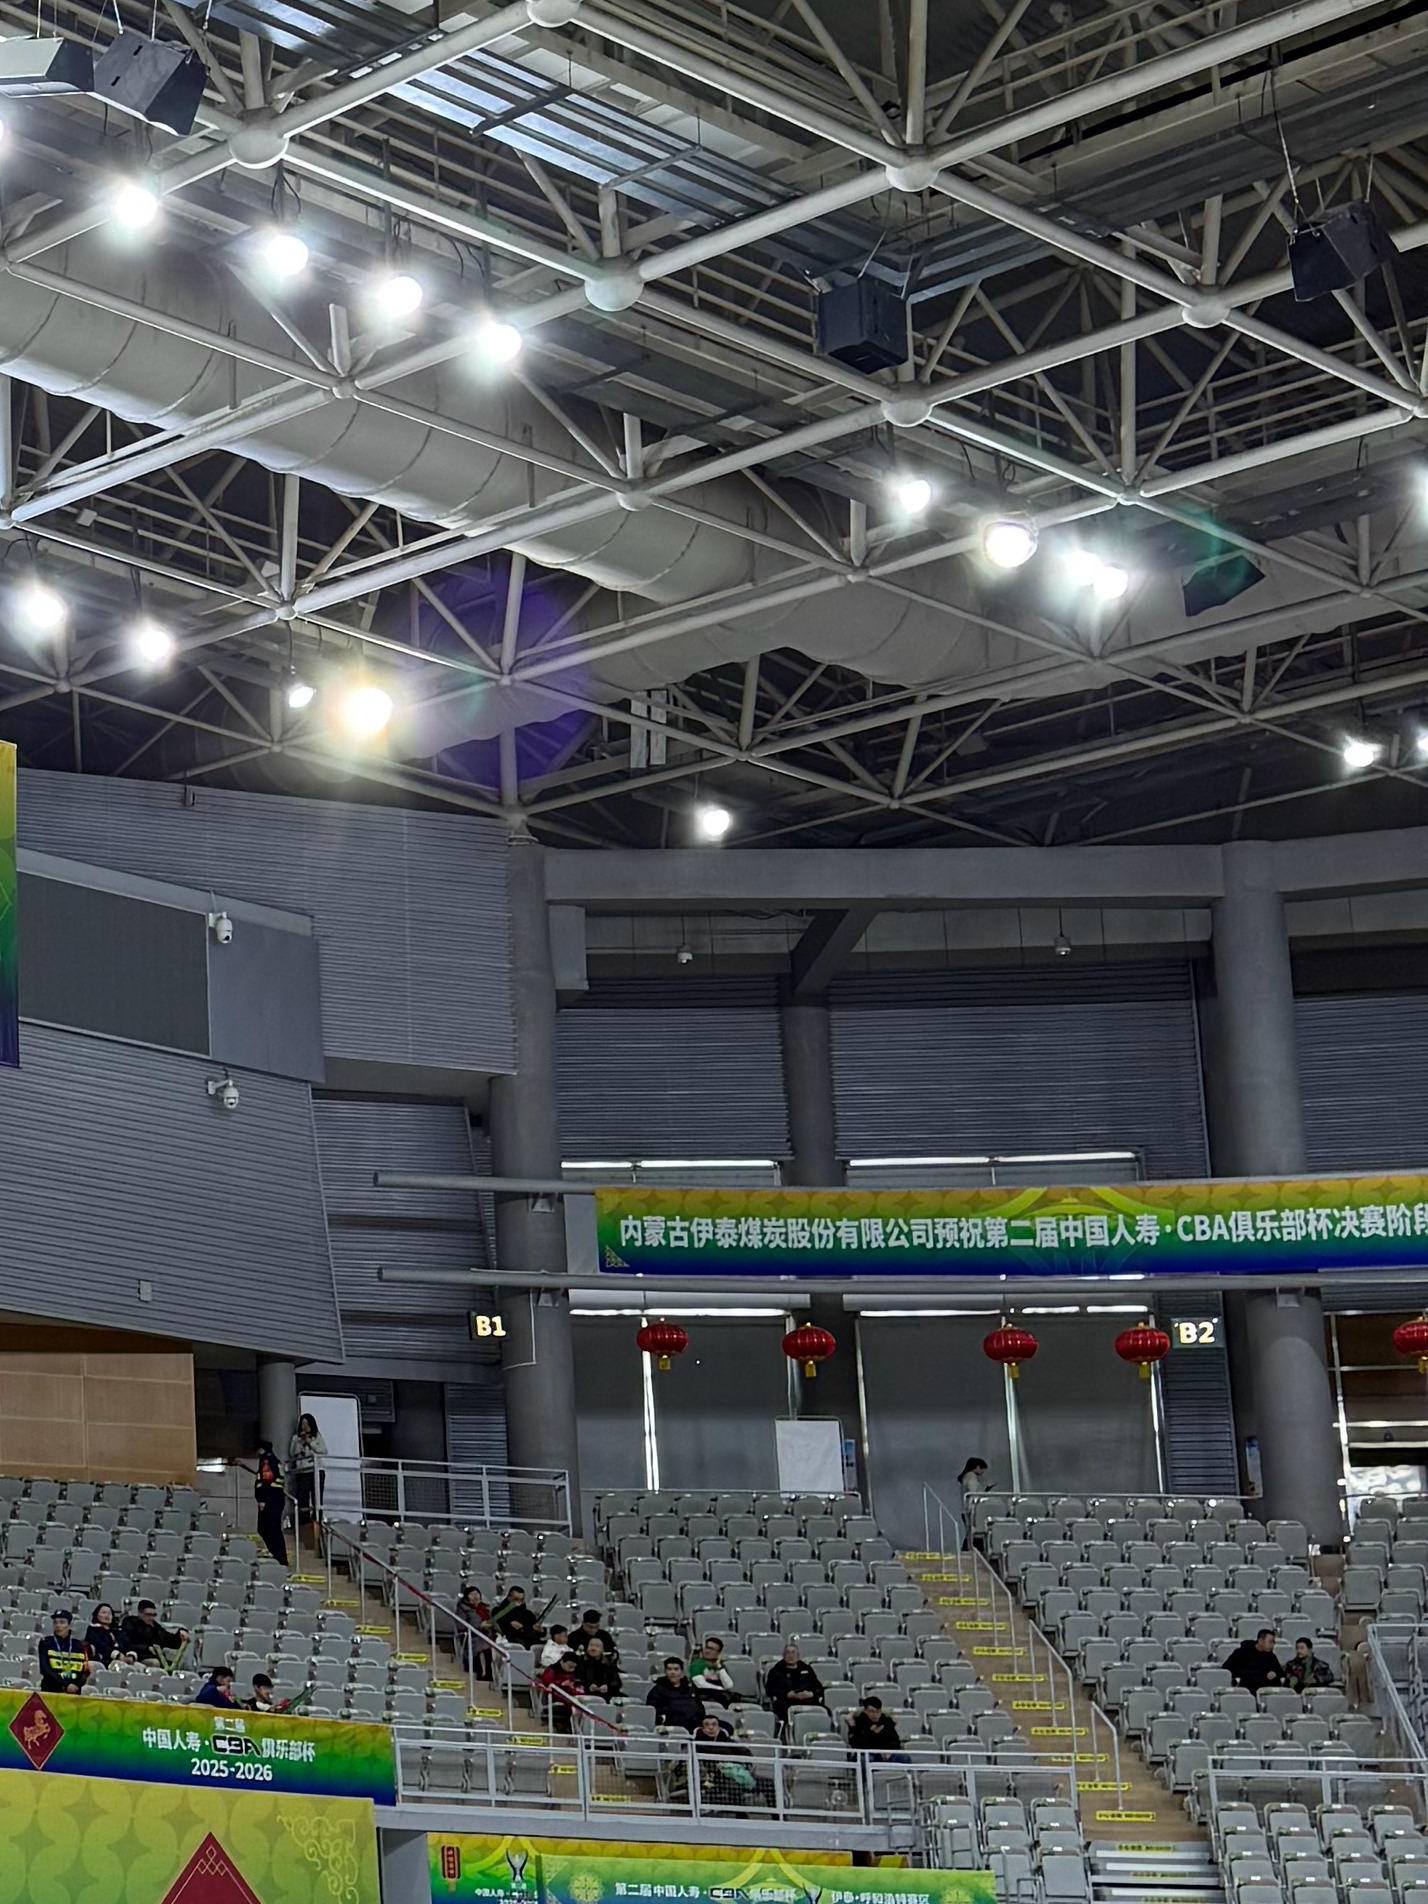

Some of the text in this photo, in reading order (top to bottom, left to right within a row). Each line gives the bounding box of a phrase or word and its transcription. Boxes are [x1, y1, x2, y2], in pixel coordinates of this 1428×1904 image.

[476, 1315, 503, 1339] B1
[1179, 1321, 1215, 1344] B2
[191, 1758, 273, 1782] 2025-2026
